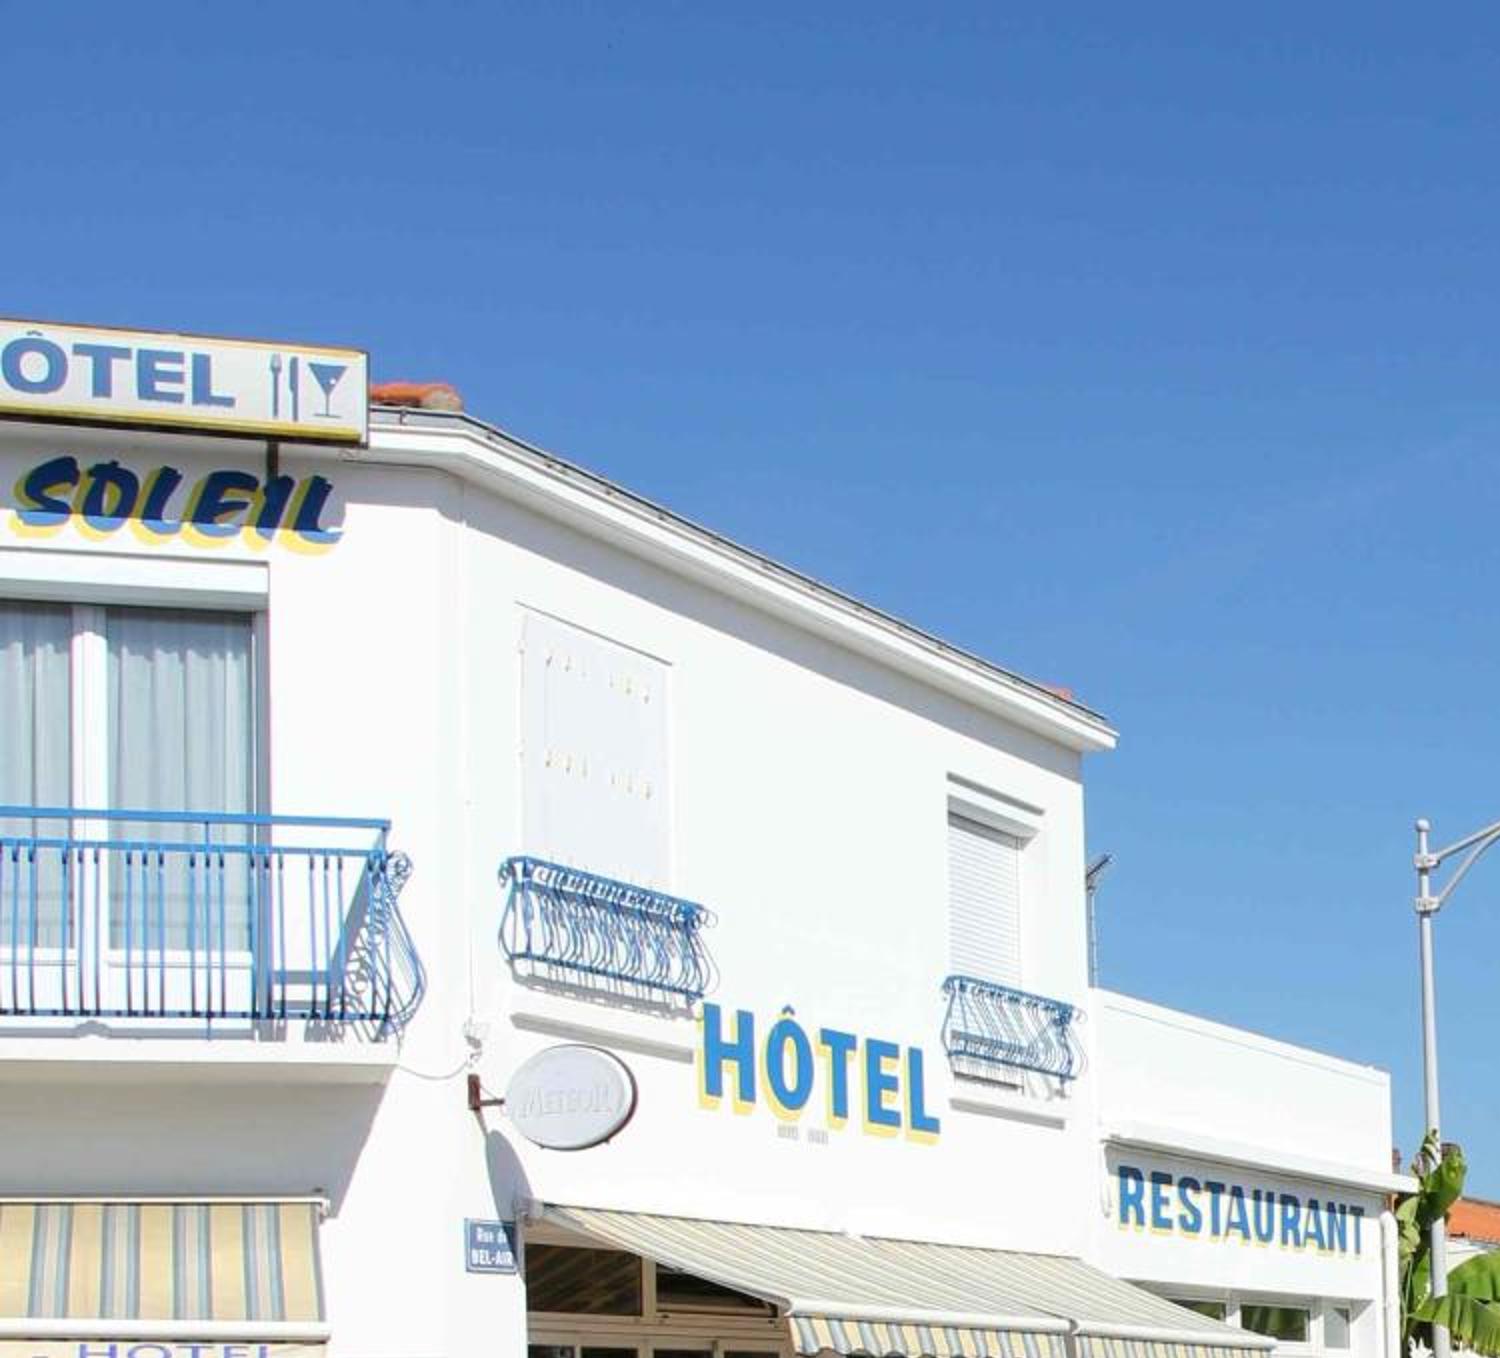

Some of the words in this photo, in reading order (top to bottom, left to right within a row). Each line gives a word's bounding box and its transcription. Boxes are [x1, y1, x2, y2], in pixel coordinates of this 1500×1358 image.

[11, 455, 344, 553] SOLEIL
[700, 1002, 940, 1139] HÔTEL
[1118, 1165, 1365, 1256] RESTAURANT
[471, 1250, 514, 1266] BEL-AIR
